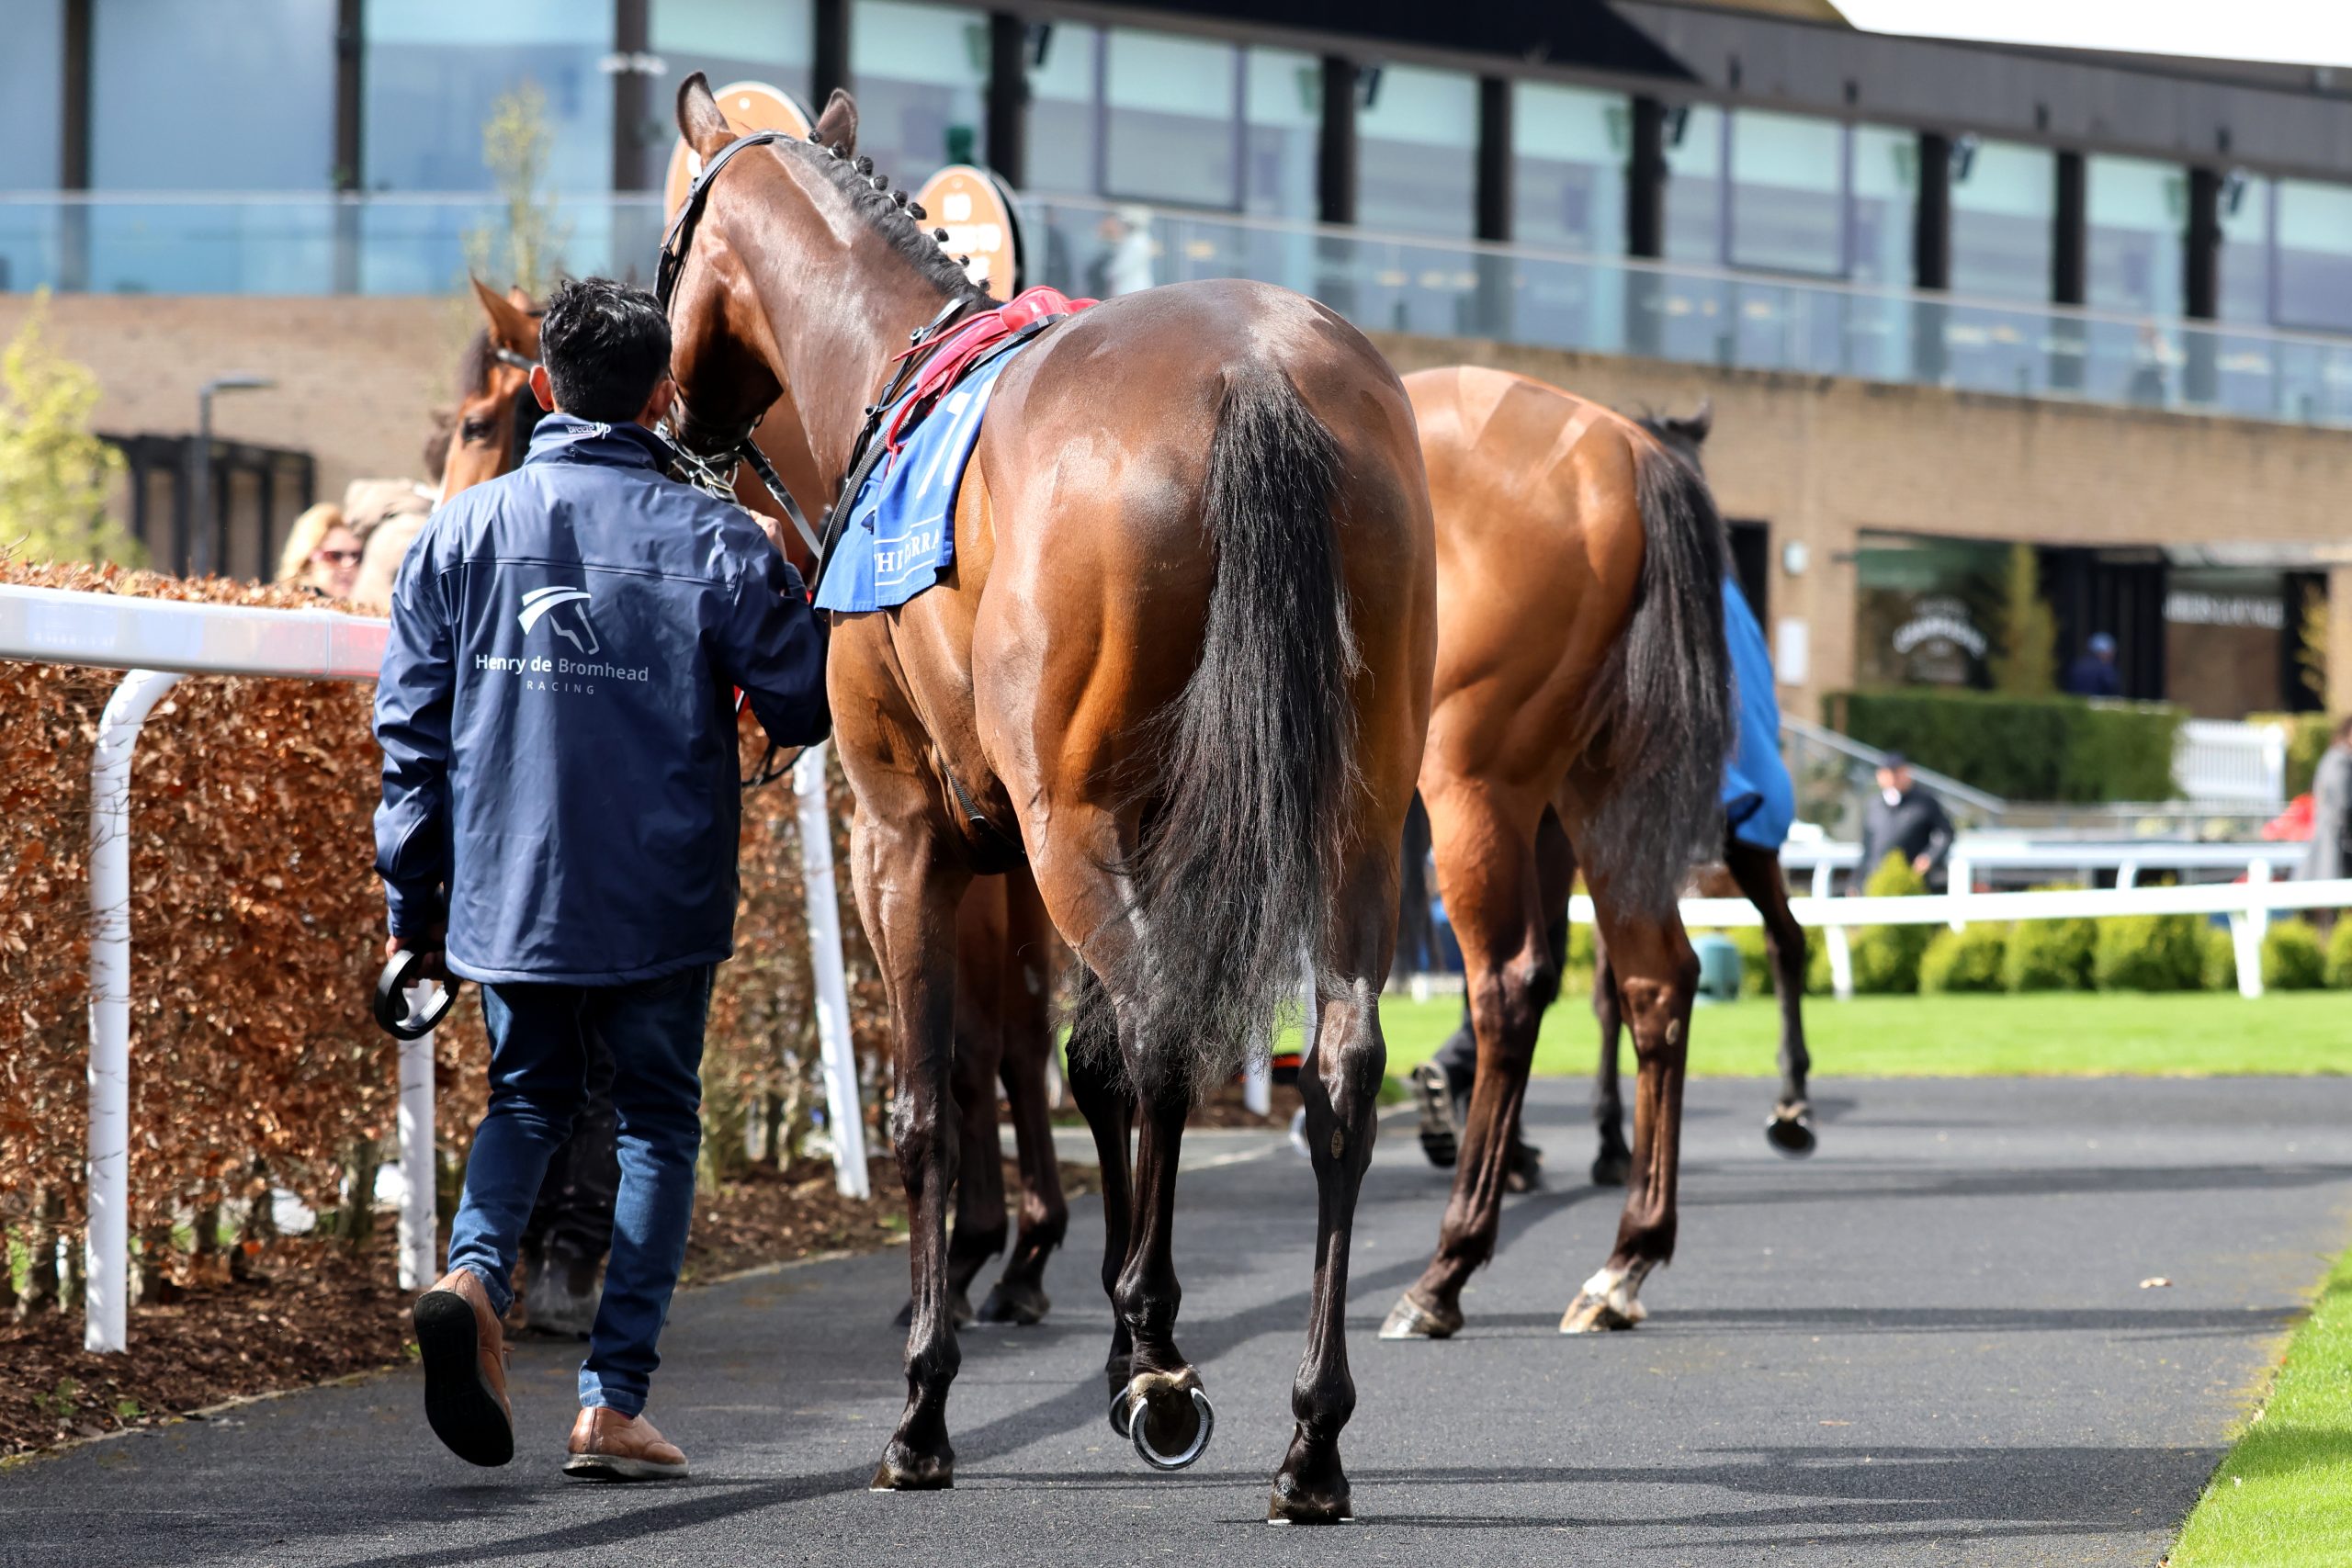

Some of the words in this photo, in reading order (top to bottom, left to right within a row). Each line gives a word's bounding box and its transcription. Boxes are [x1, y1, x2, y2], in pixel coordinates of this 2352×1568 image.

[476, 654, 526, 675] Henry
[530, 656, 552, 672] de
[559, 659, 649, 682] Bromhead
[526, 681, 594, 695] RACING
